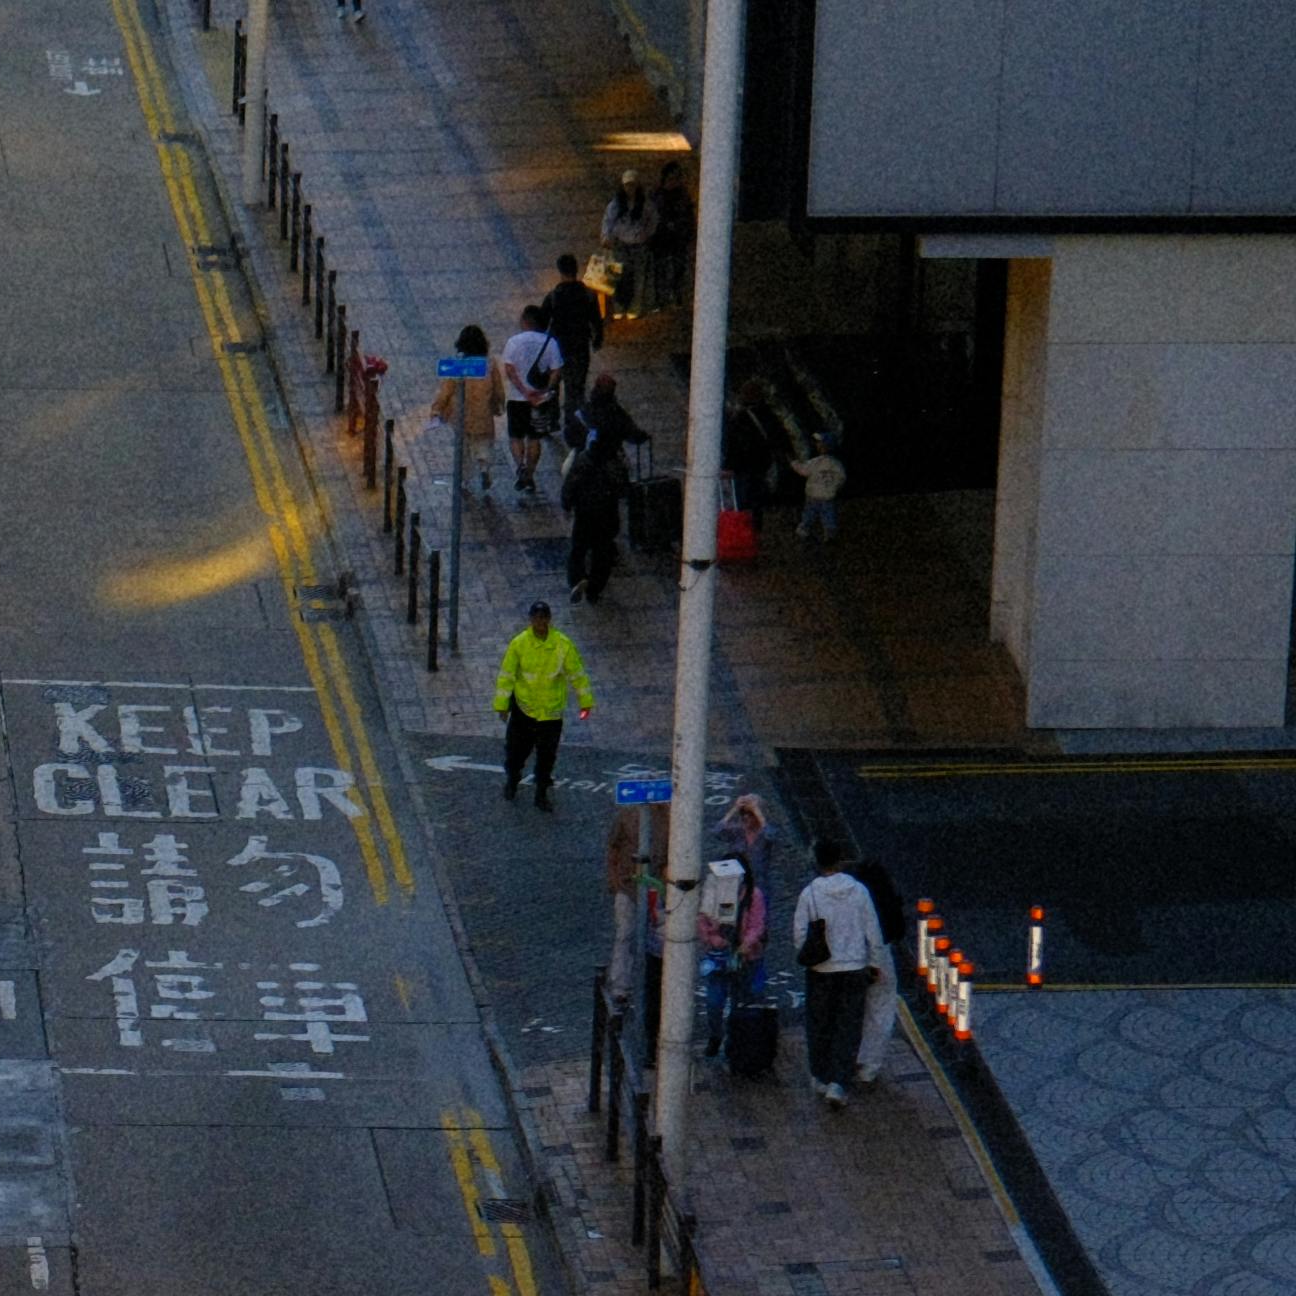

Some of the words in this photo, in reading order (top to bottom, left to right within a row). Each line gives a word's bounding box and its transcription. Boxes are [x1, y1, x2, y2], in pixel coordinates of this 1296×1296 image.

[55, 702, 304, 757] KEEP
[33, 762, 369, 821] CLEAR
[82, 832, 345, 929] 請勿
[85, 949, 371, 1056] 停車
